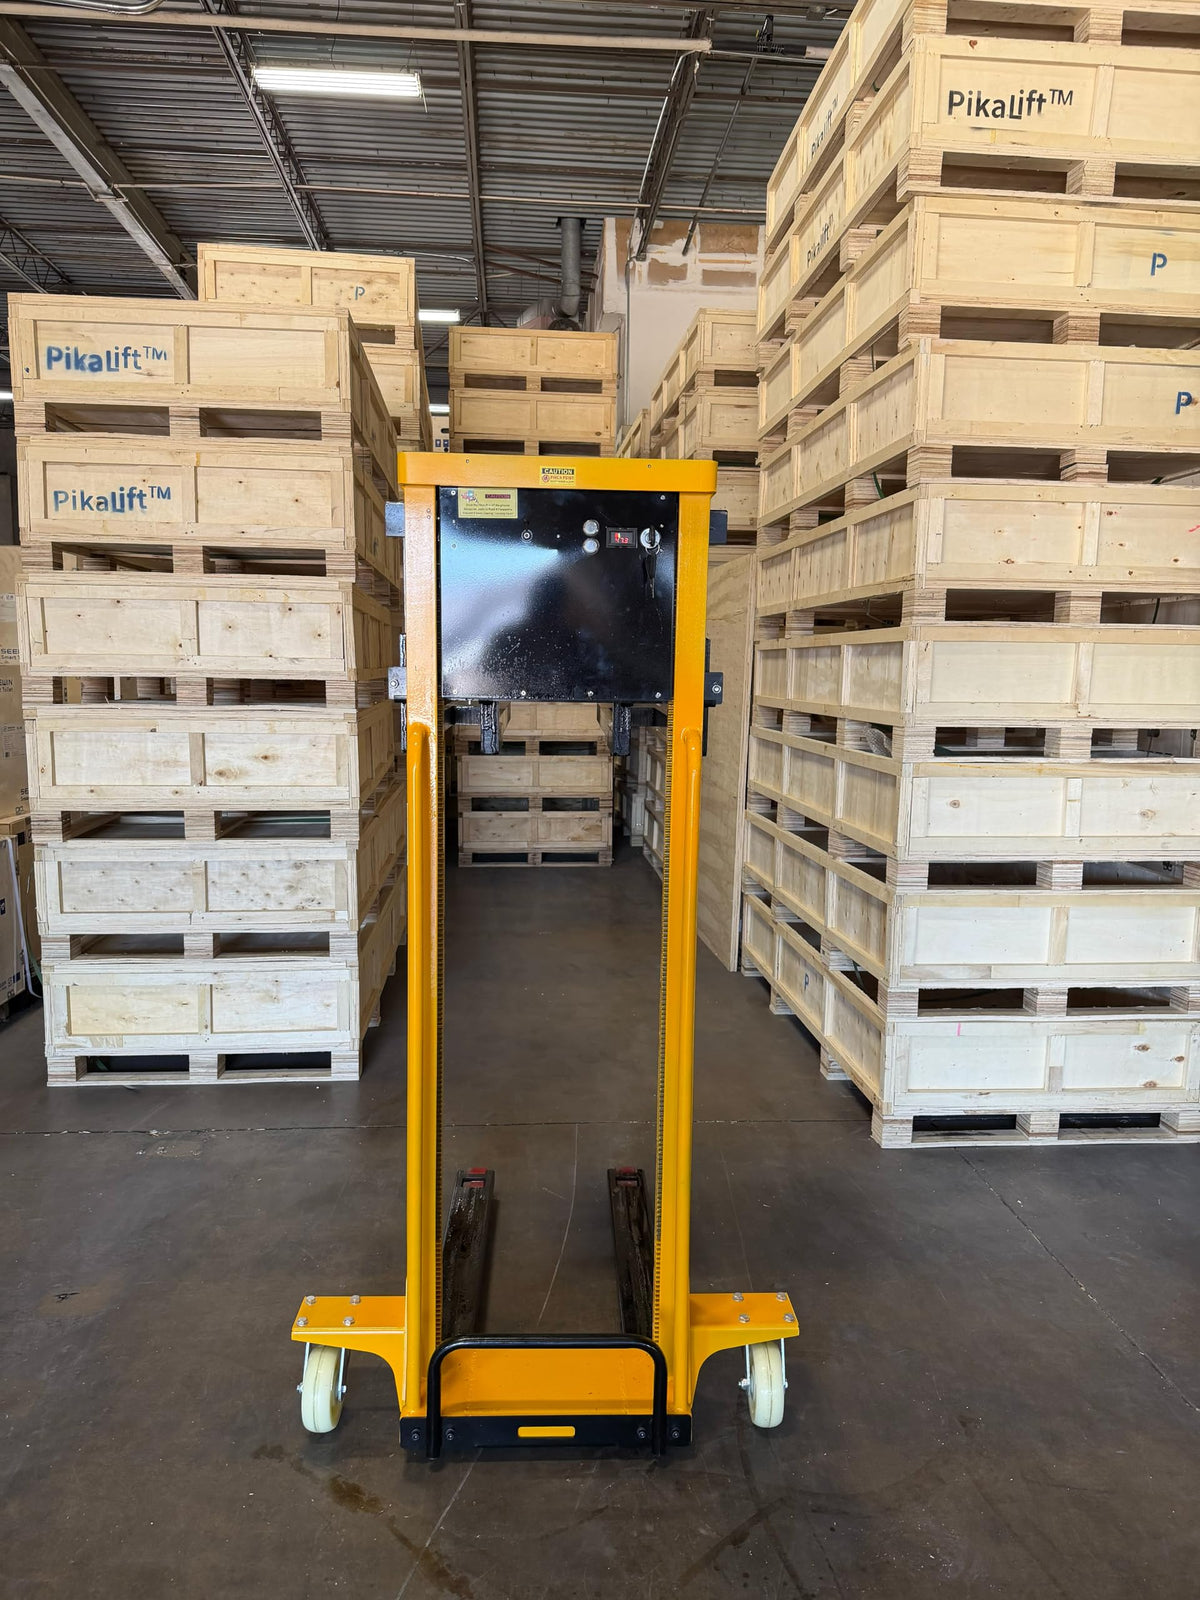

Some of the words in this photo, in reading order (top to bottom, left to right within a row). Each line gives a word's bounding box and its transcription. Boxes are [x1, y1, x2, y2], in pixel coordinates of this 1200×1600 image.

[1150, 252, 1168, 276] P
[354, 285, 366, 301] P
[1174, 391, 1193, 415] P
